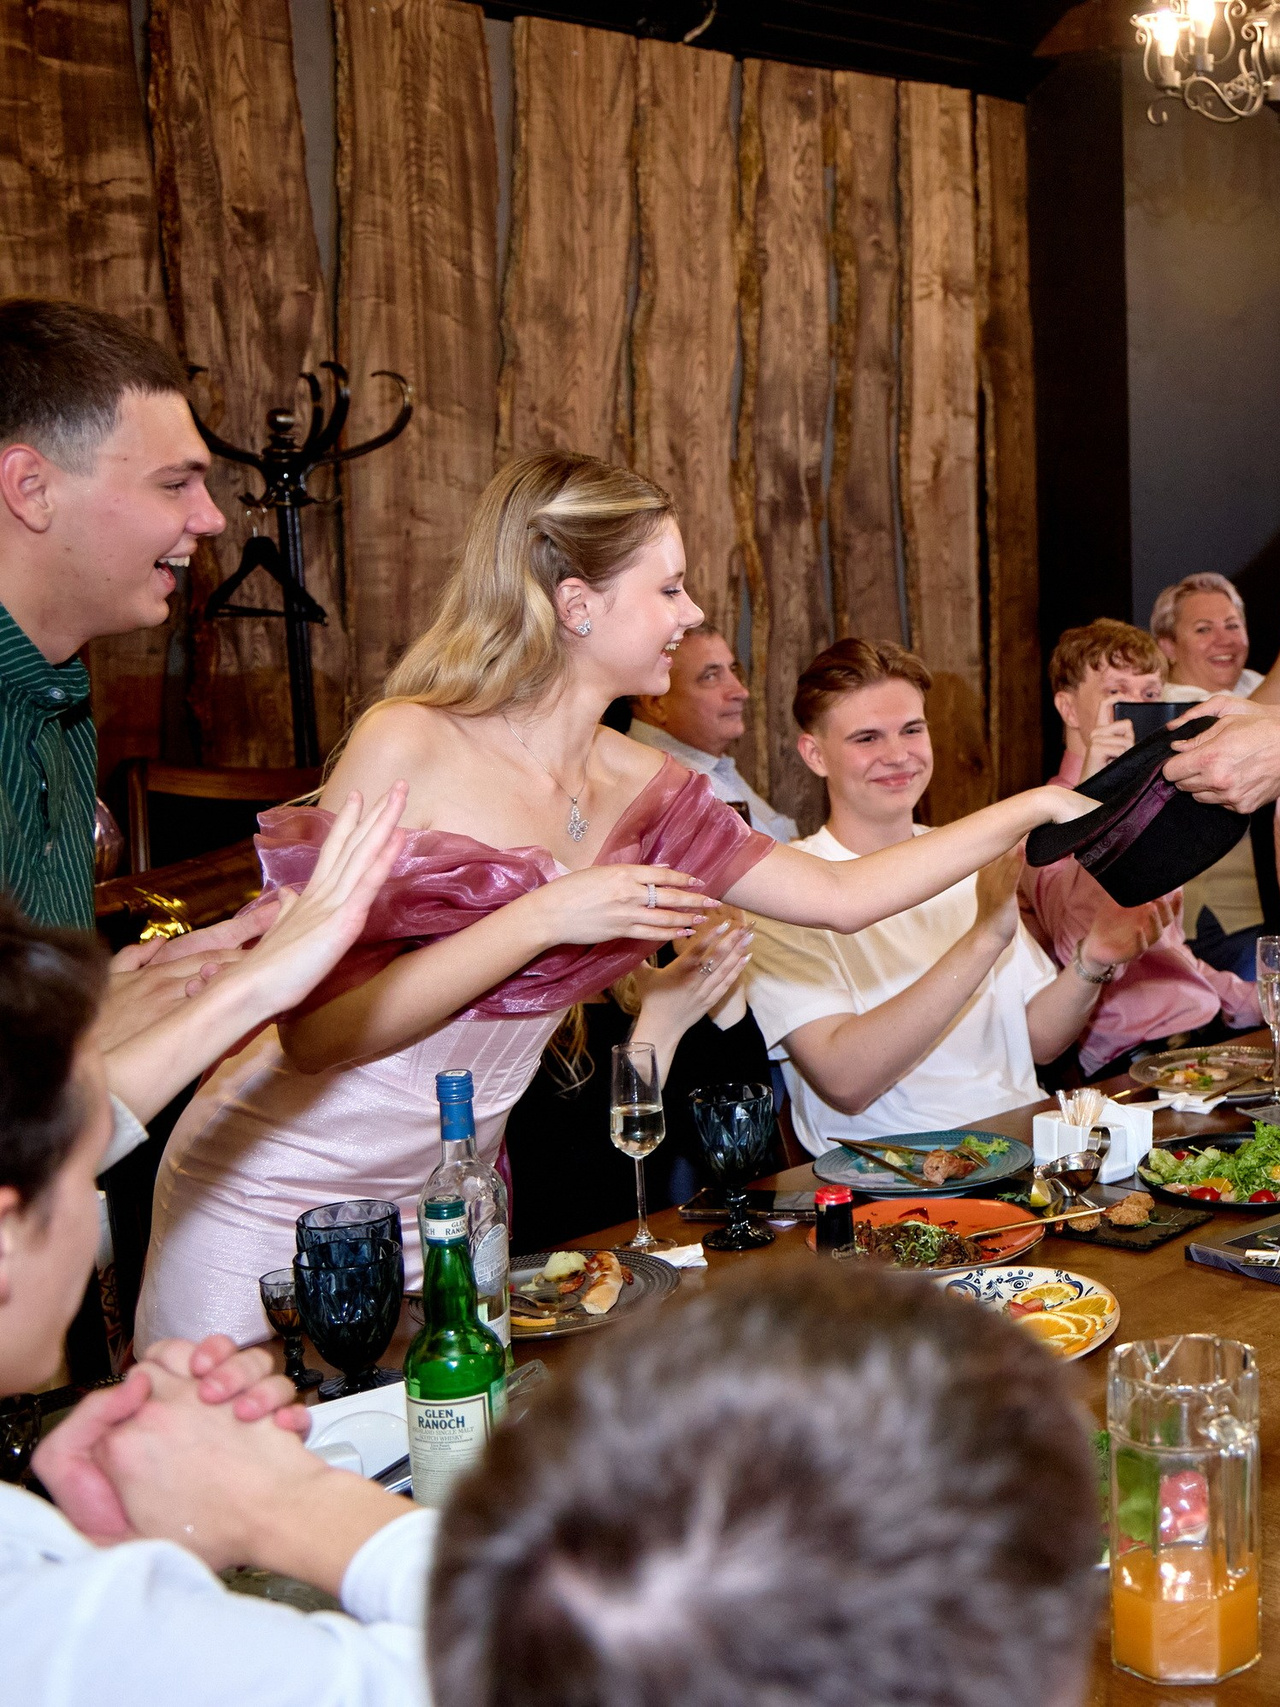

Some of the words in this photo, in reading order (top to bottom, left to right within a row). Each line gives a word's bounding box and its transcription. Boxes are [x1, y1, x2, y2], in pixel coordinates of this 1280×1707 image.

[424, 1408, 454, 1418] GLEN
[417, 1415, 466, 1430] RANOCH
[458, 1426, 475, 1434] MALT
